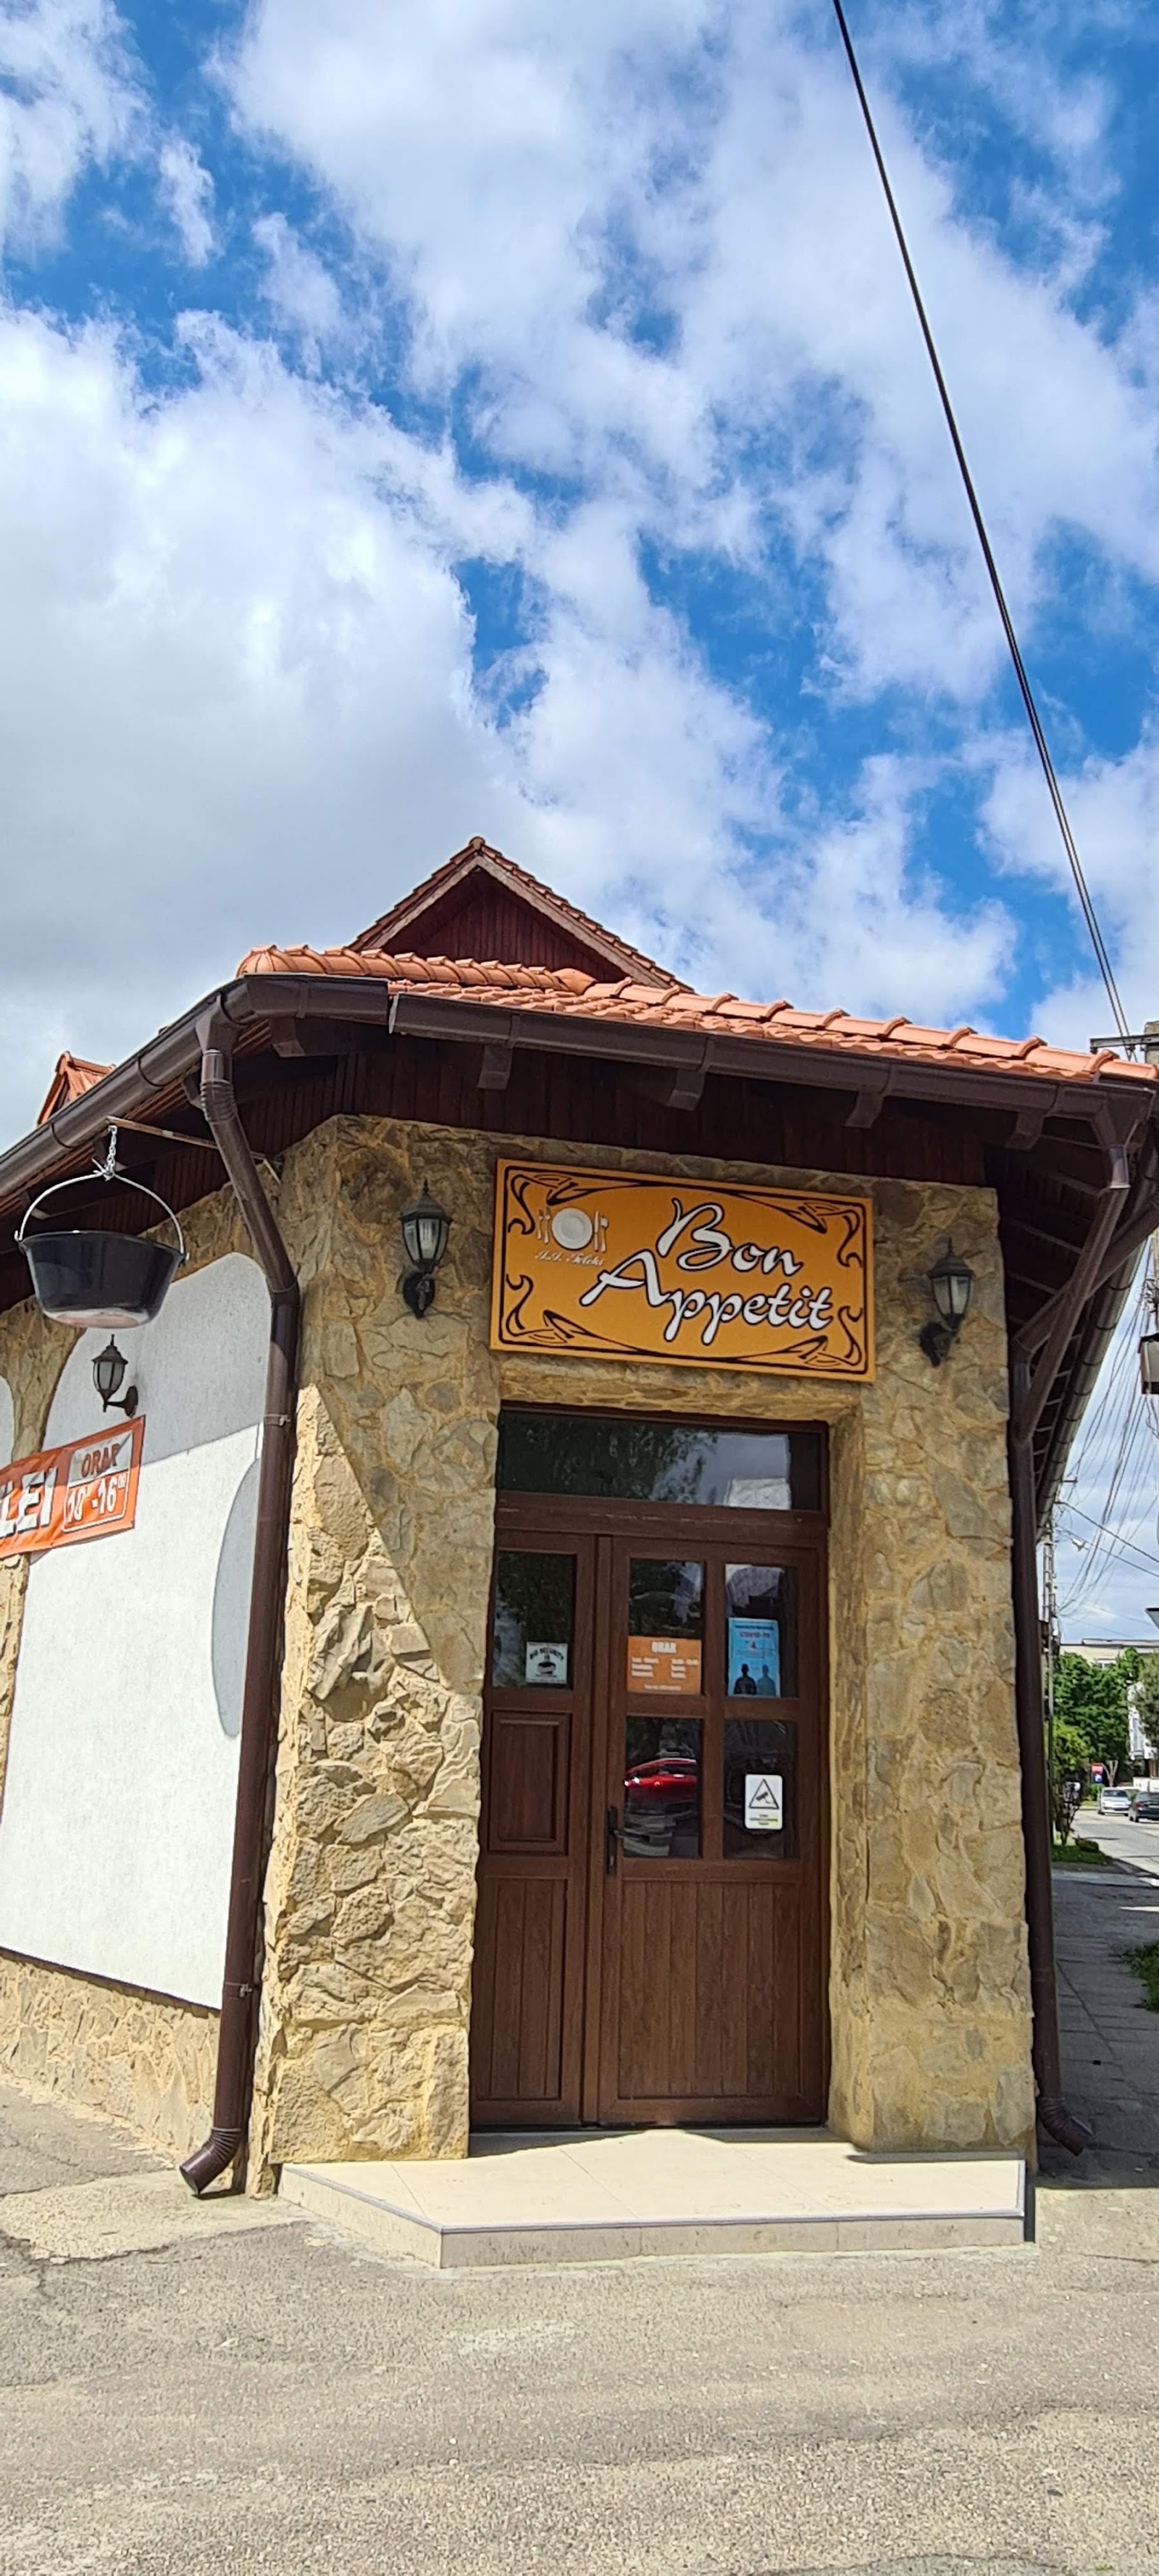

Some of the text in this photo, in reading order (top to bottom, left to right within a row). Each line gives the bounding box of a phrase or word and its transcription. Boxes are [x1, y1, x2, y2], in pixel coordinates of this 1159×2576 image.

[656, 1197, 802, 1276] Bon
[580, 1249, 832, 1346] Appetit
[81, 1443, 121, 1478] ORAR
[652, 1642, 677, 1654] ORAR
